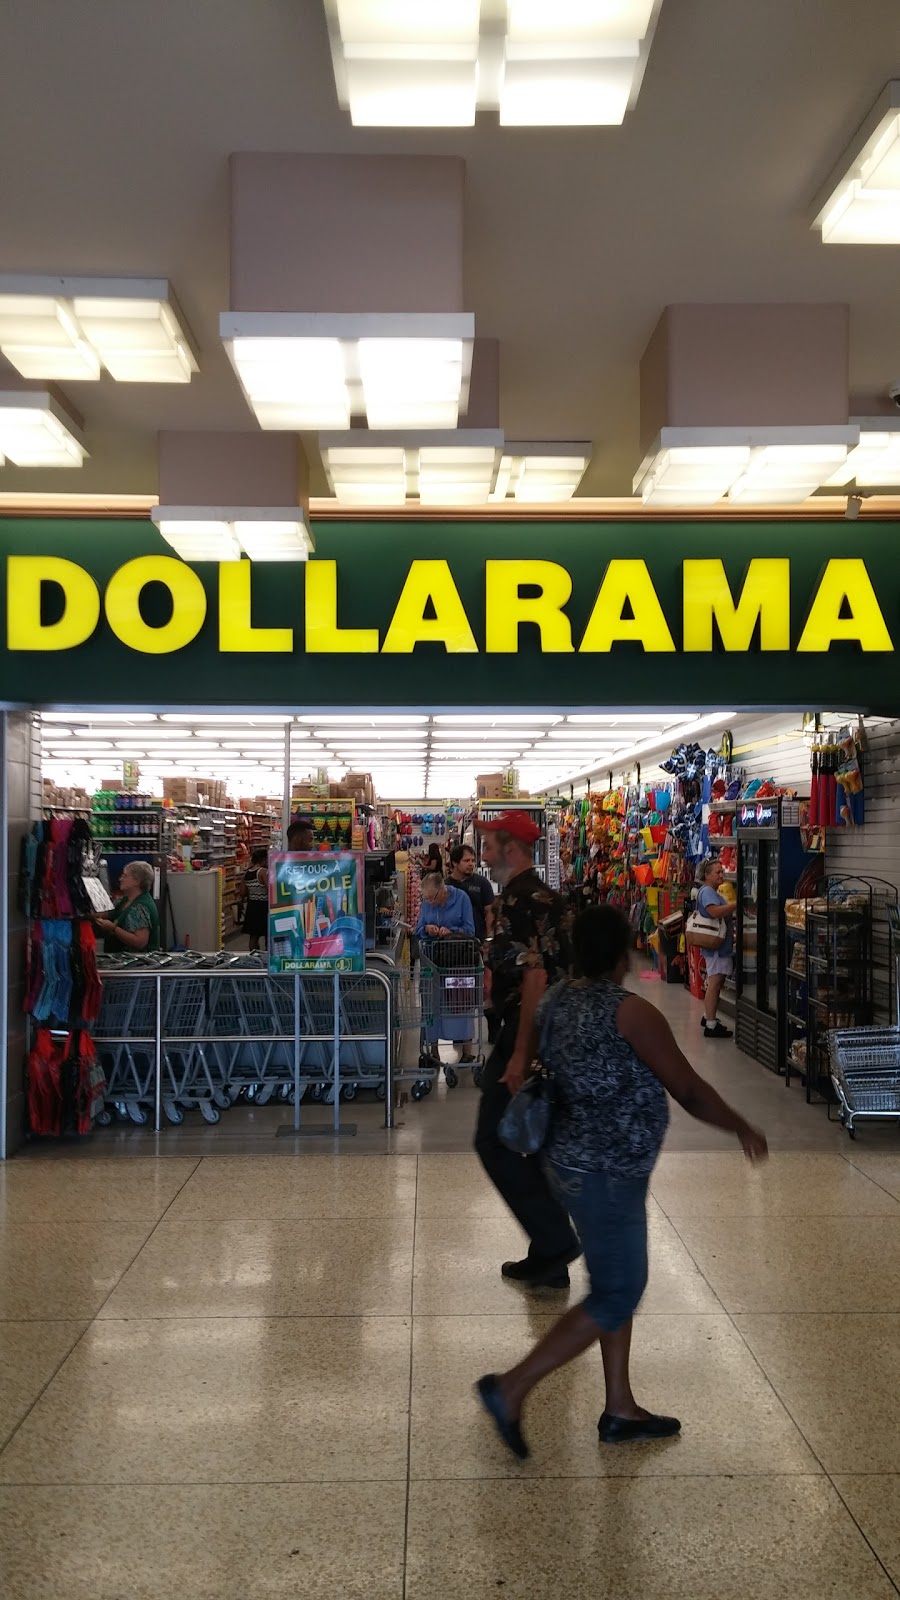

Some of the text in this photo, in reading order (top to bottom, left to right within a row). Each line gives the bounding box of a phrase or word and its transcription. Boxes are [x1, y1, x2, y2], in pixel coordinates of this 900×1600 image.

[6, 555, 895, 653] DOLLARAMA
[285, 860, 341, 875] RETOUR À
[284, 961, 332, 969] DOLLARAMA
